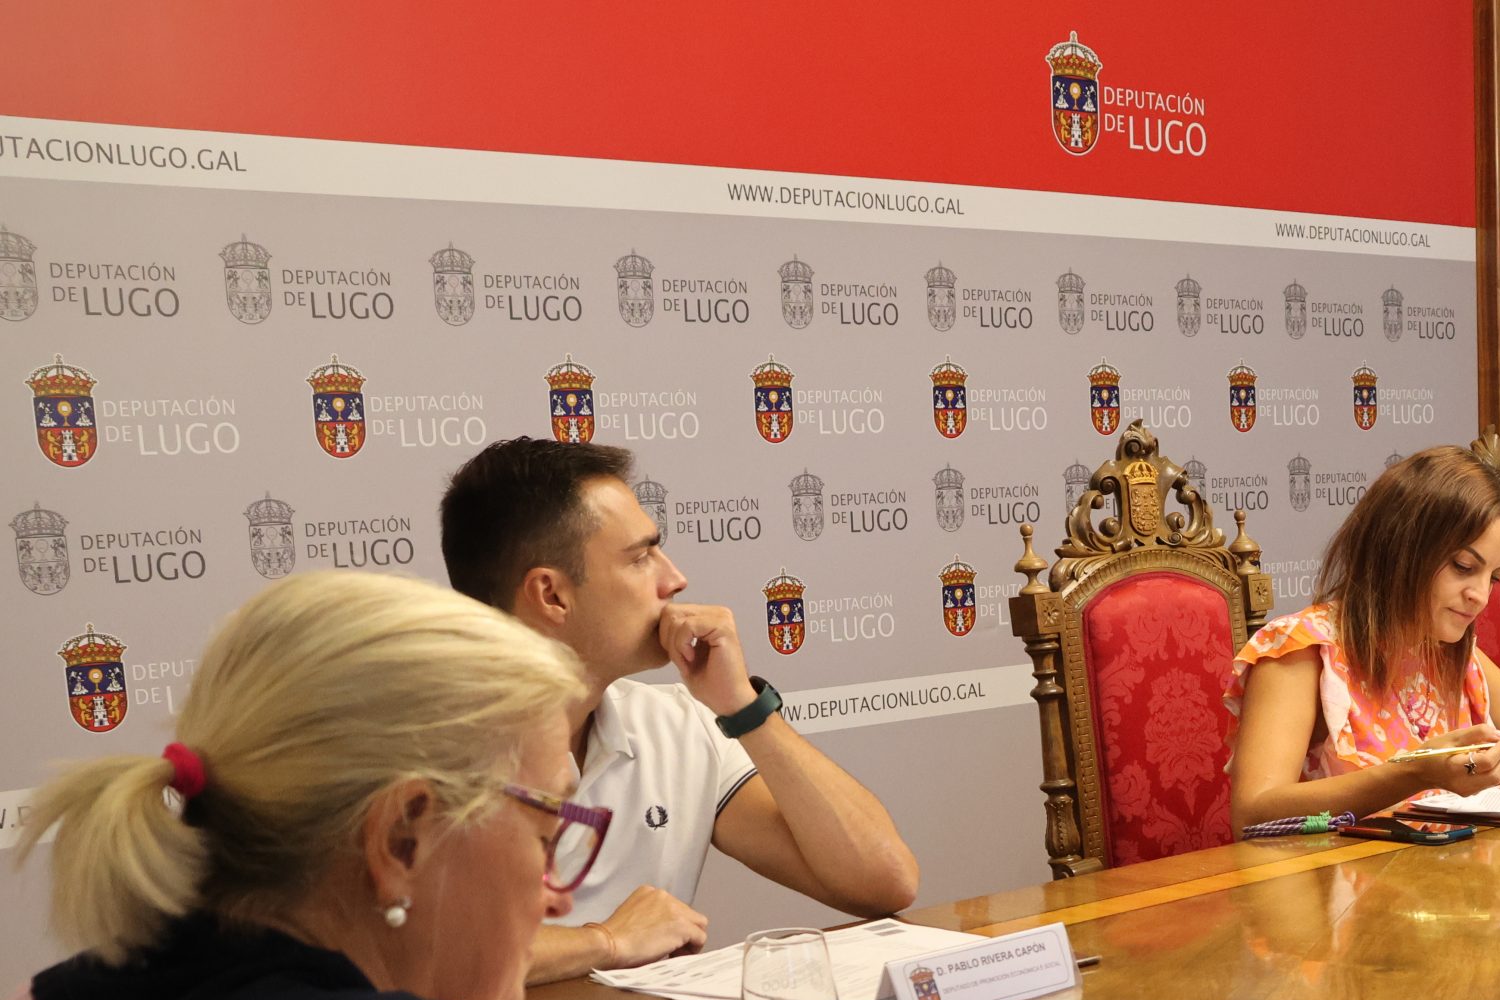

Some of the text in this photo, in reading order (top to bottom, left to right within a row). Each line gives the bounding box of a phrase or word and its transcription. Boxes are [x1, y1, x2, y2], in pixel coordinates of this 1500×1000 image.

[1104, 87, 1204, 116] DEPUTACIÓN
[1105, 113, 1206, 156] DE LUGO
[728, 184, 964, 215] WWW.DEPUTACIONLUGO.GAL
[1276, 224, 1430, 247] WWW.DEPUTACIONLUGO.GAL
[49, 263, 175, 281] DEPUTACIÓN
[282, 268, 390, 286] DEPUTACIÓN
[484, 274, 579, 290] DEPUTACIÓN
[662, 279, 747, 294] DEPUTACIÓN
[821, 283, 896, 297] DEPUTACIÓN
[963, 289, 1031, 302] DEPUTACIÓN
[52, 286, 179, 317] DE LUGO
[284, 292, 394, 319] DE LUGO
[485, 295, 582, 321] DE LUGO
[1091, 293, 1152, 307] DEPUTACIÓN
[1207, 298, 1263, 310] DEPUTACIÓN
[1312, 301, 1363, 314] DEPUTACIÓN
[664, 298, 749, 323] DE LUGO
[822, 302, 898, 325] DE LUGO
[964, 306, 1032, 329] DE LUGO
[1092, 310, 1153, 331] DE LUGO
[1407, 307, 1454, 318] DEPUTACIÓN
[1207, 314, 1264, 334] DE LUGO
[1312, 317, 1364, 337] DE LUGO
[1408, 321, 1455, 340] DE LUGO
[370, 392, 483, 412] DEPUTACIÓN
[599, 389, 696, 407] DEPUTACIÓN
[798, 387, 882, 404] DEPUTACIÓN
[970, 387, 1045, 402] DEPUTACIÓN
[1123, 386, 1190, 401] DEPUTACIÓN
[1259, 387, 1318, 400] DEPUTACIÓN
[1379, 387, 1433, 400] DEPUTACIÓN
[103, 395, 235, 417] DEPUTACIÓN
[1259, 405, 1319, 425] DE LUGO
[1380, 404, 1433, 424] DE LUGO
[600, 412, 699, 440] DE LUGO
[798, 408, 884, 434] DE LUGO
[972, 407, 1047, 431] DE LUGO
[1124, 405, 1191, 428] DE LUGO
[105, 422, 239, 455] DE LUGO
[373, 417, 486, 447] DE LUGO
[1212, 474, 1267, 488] DEPUTACIÓN
[1316, 472, 1367, 484] DEPUTACIÓN
[831, 489, 906, 506] DEPUTACIÓN
[971, 484, 1038, 499] DEPUTACIÓN
[1212, 490, 1269, 511] DE LUGO
[1317, 488, 1326, 498] DE
[676, 496, 759, 515] DEPUTACIÓN
[972, 501, 1040, 524] DE LUGO
[305, 515, 410, 537] DEPUTACIÓN
[677, 516, 761, 543] DE LUGO
[832, 508, 907, 532] DE LUGO
[81, 527, 201, 550] DEPUTACIÓN
[307, 538, 414, 568] DE LUGO
[84, 551, 205, 583] DE LUGO
[809, 592, 893, 614] DEPUTACIÓN
[981, 603, 995, 617] DE
[810, 613, 894, 642] DE LUGO
[135, 688, 162, 705] DE
[937, 941, 1046, 977] D. PABLO RIVERA CAPÓN
